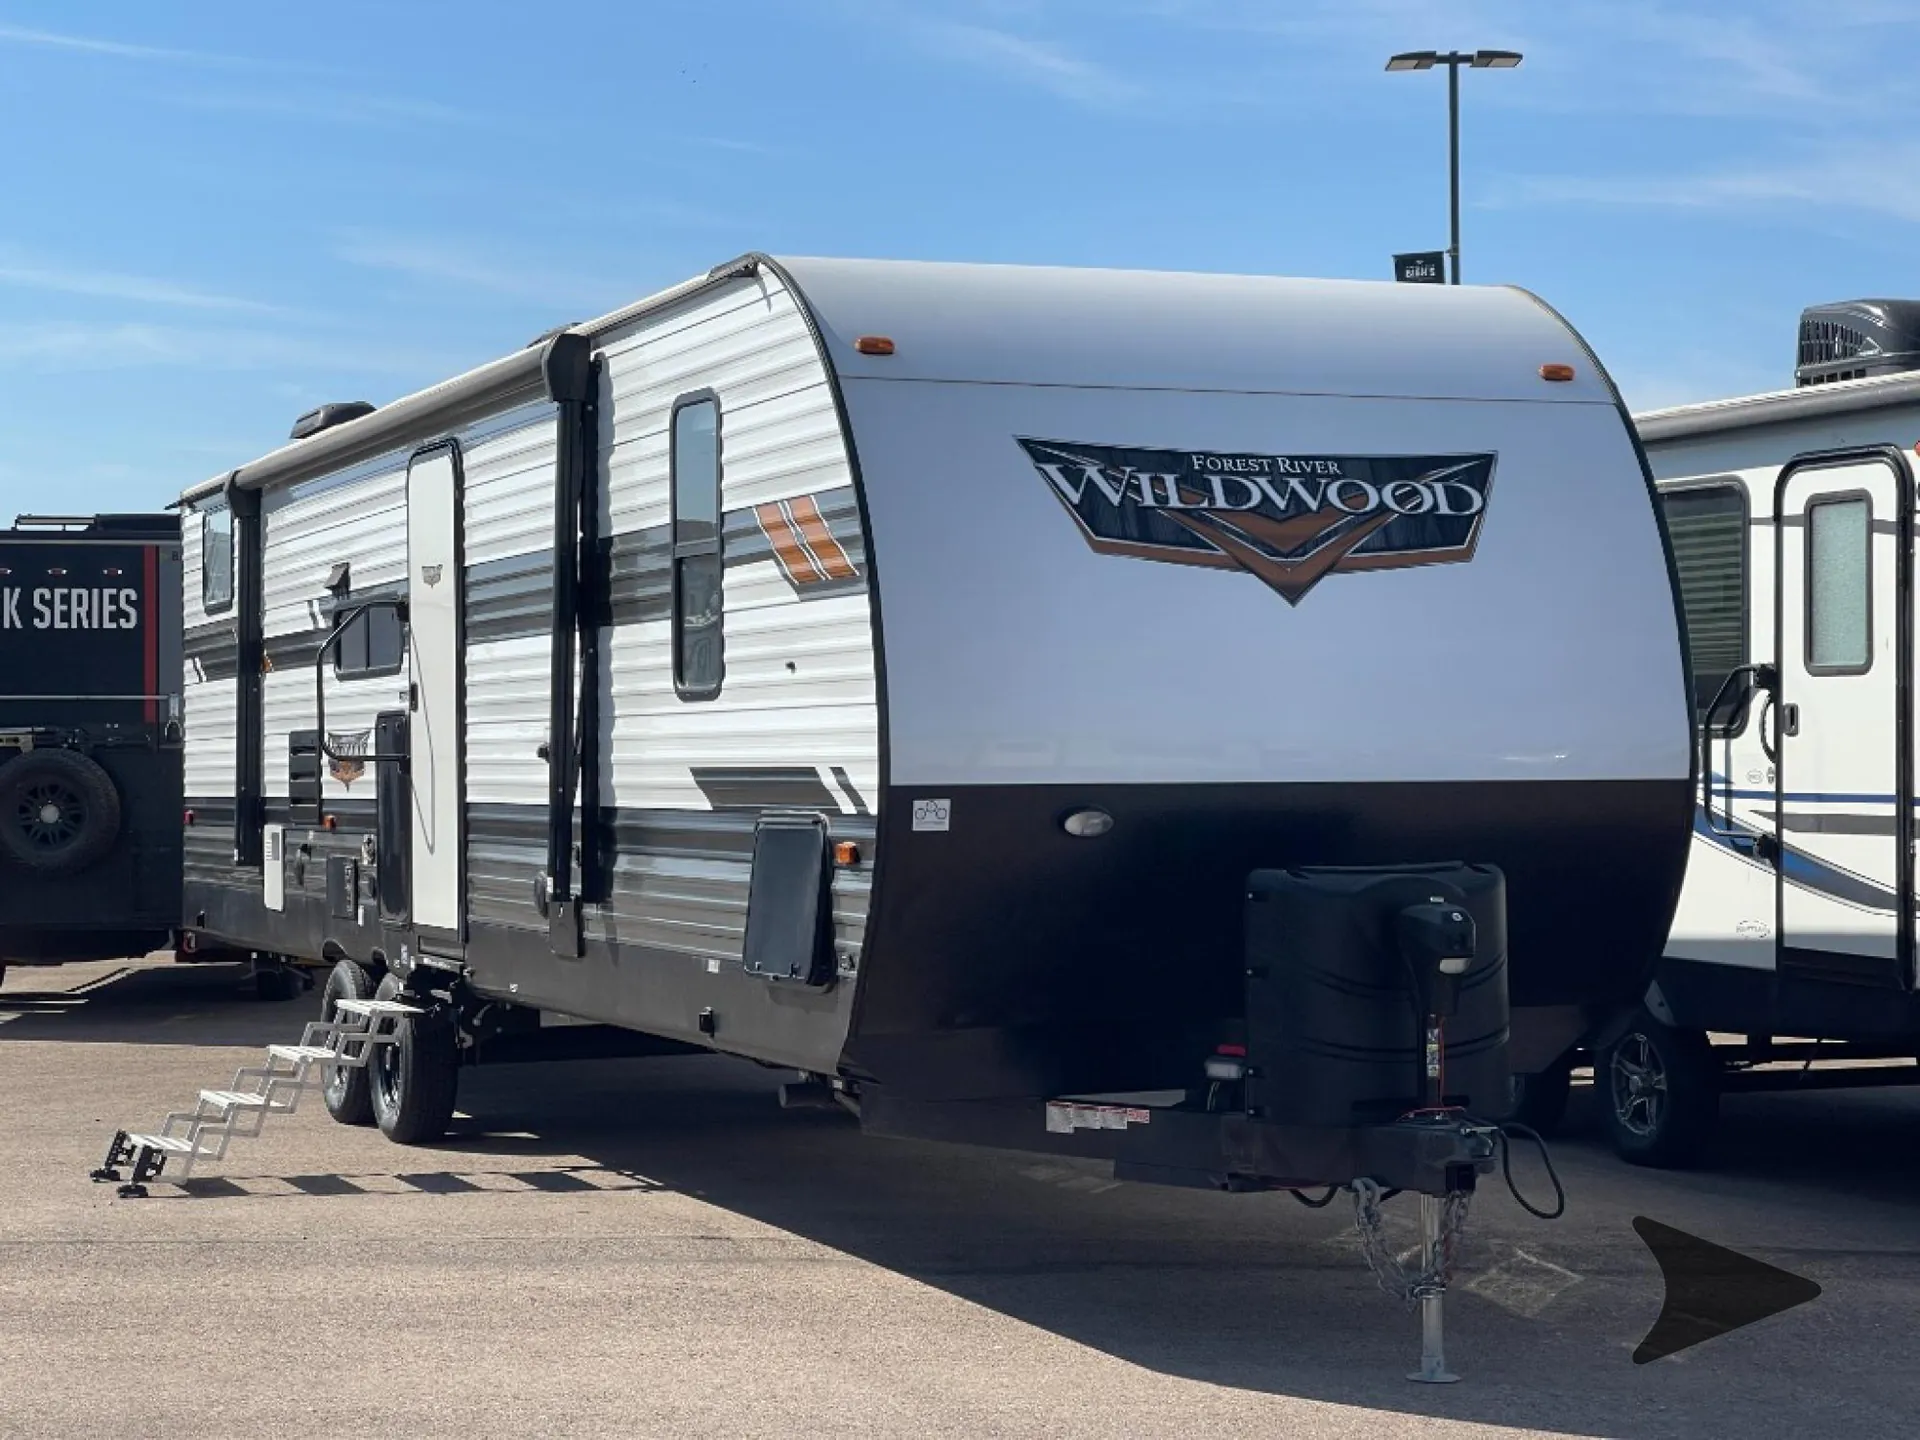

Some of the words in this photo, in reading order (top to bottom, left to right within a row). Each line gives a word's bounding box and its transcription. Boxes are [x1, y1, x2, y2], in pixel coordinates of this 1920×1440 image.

[1191, 454, 1272, 472] FOREST
[1276, 456, 1342, 474] RIVER
[1034, 462, 1483, 516] WILDWOOD
[33, 587, 138, 629] SERIES
